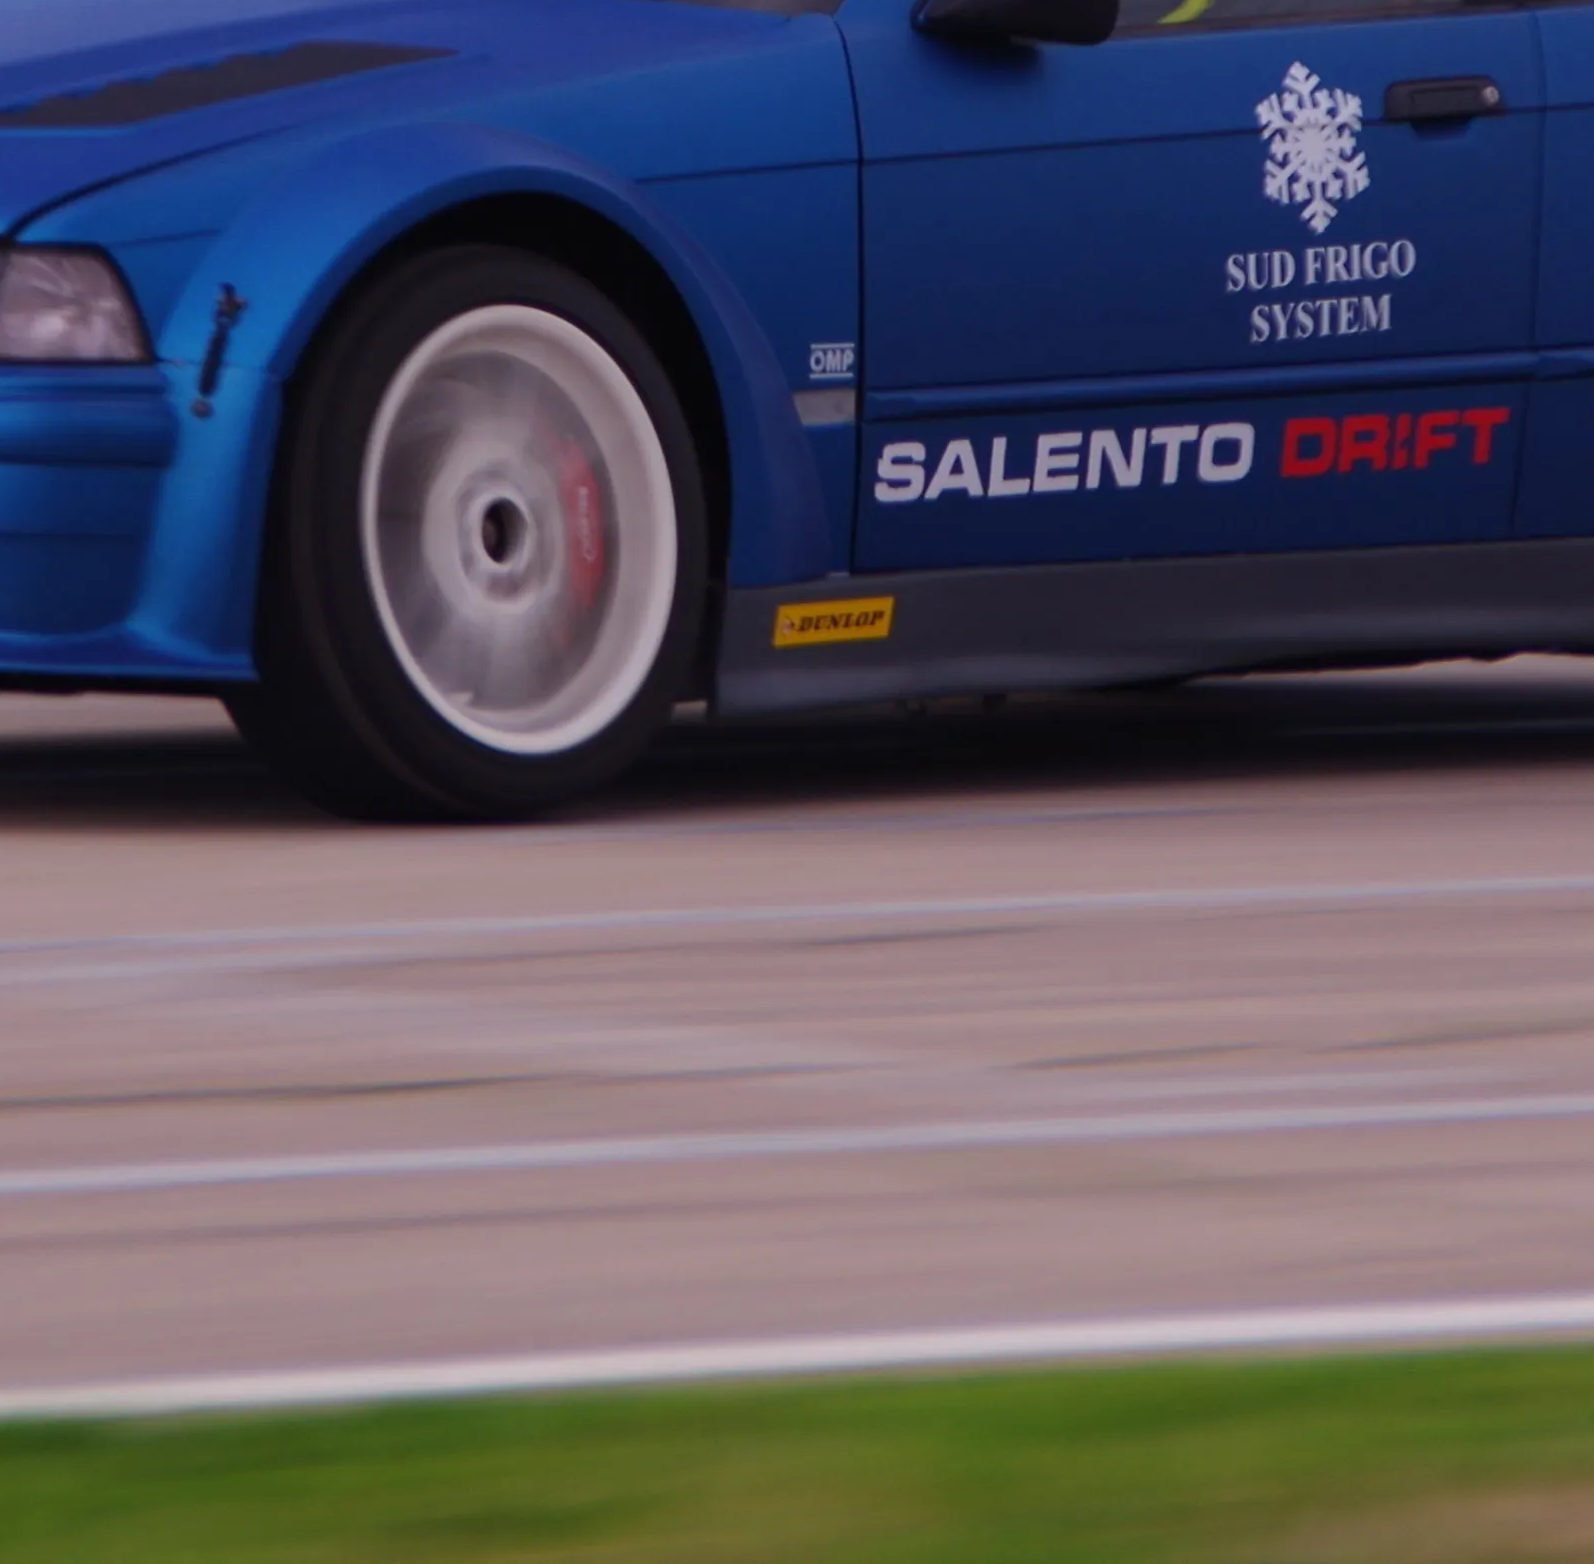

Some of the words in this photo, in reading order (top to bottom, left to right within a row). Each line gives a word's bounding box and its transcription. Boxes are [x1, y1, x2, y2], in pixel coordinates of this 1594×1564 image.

[1225, 250, 1296, 293] SUD
[1305, 239, 1417, 286] FRIGO
[1250, 293, 1393, 344] SYSTEM
[809, 348, 855, 374] OMP
[874, 422, 1256, 504] SALENTO
[1279, 406, 1511, 479] DRIFT
[796, 610, 885, 633] DUNLOP
